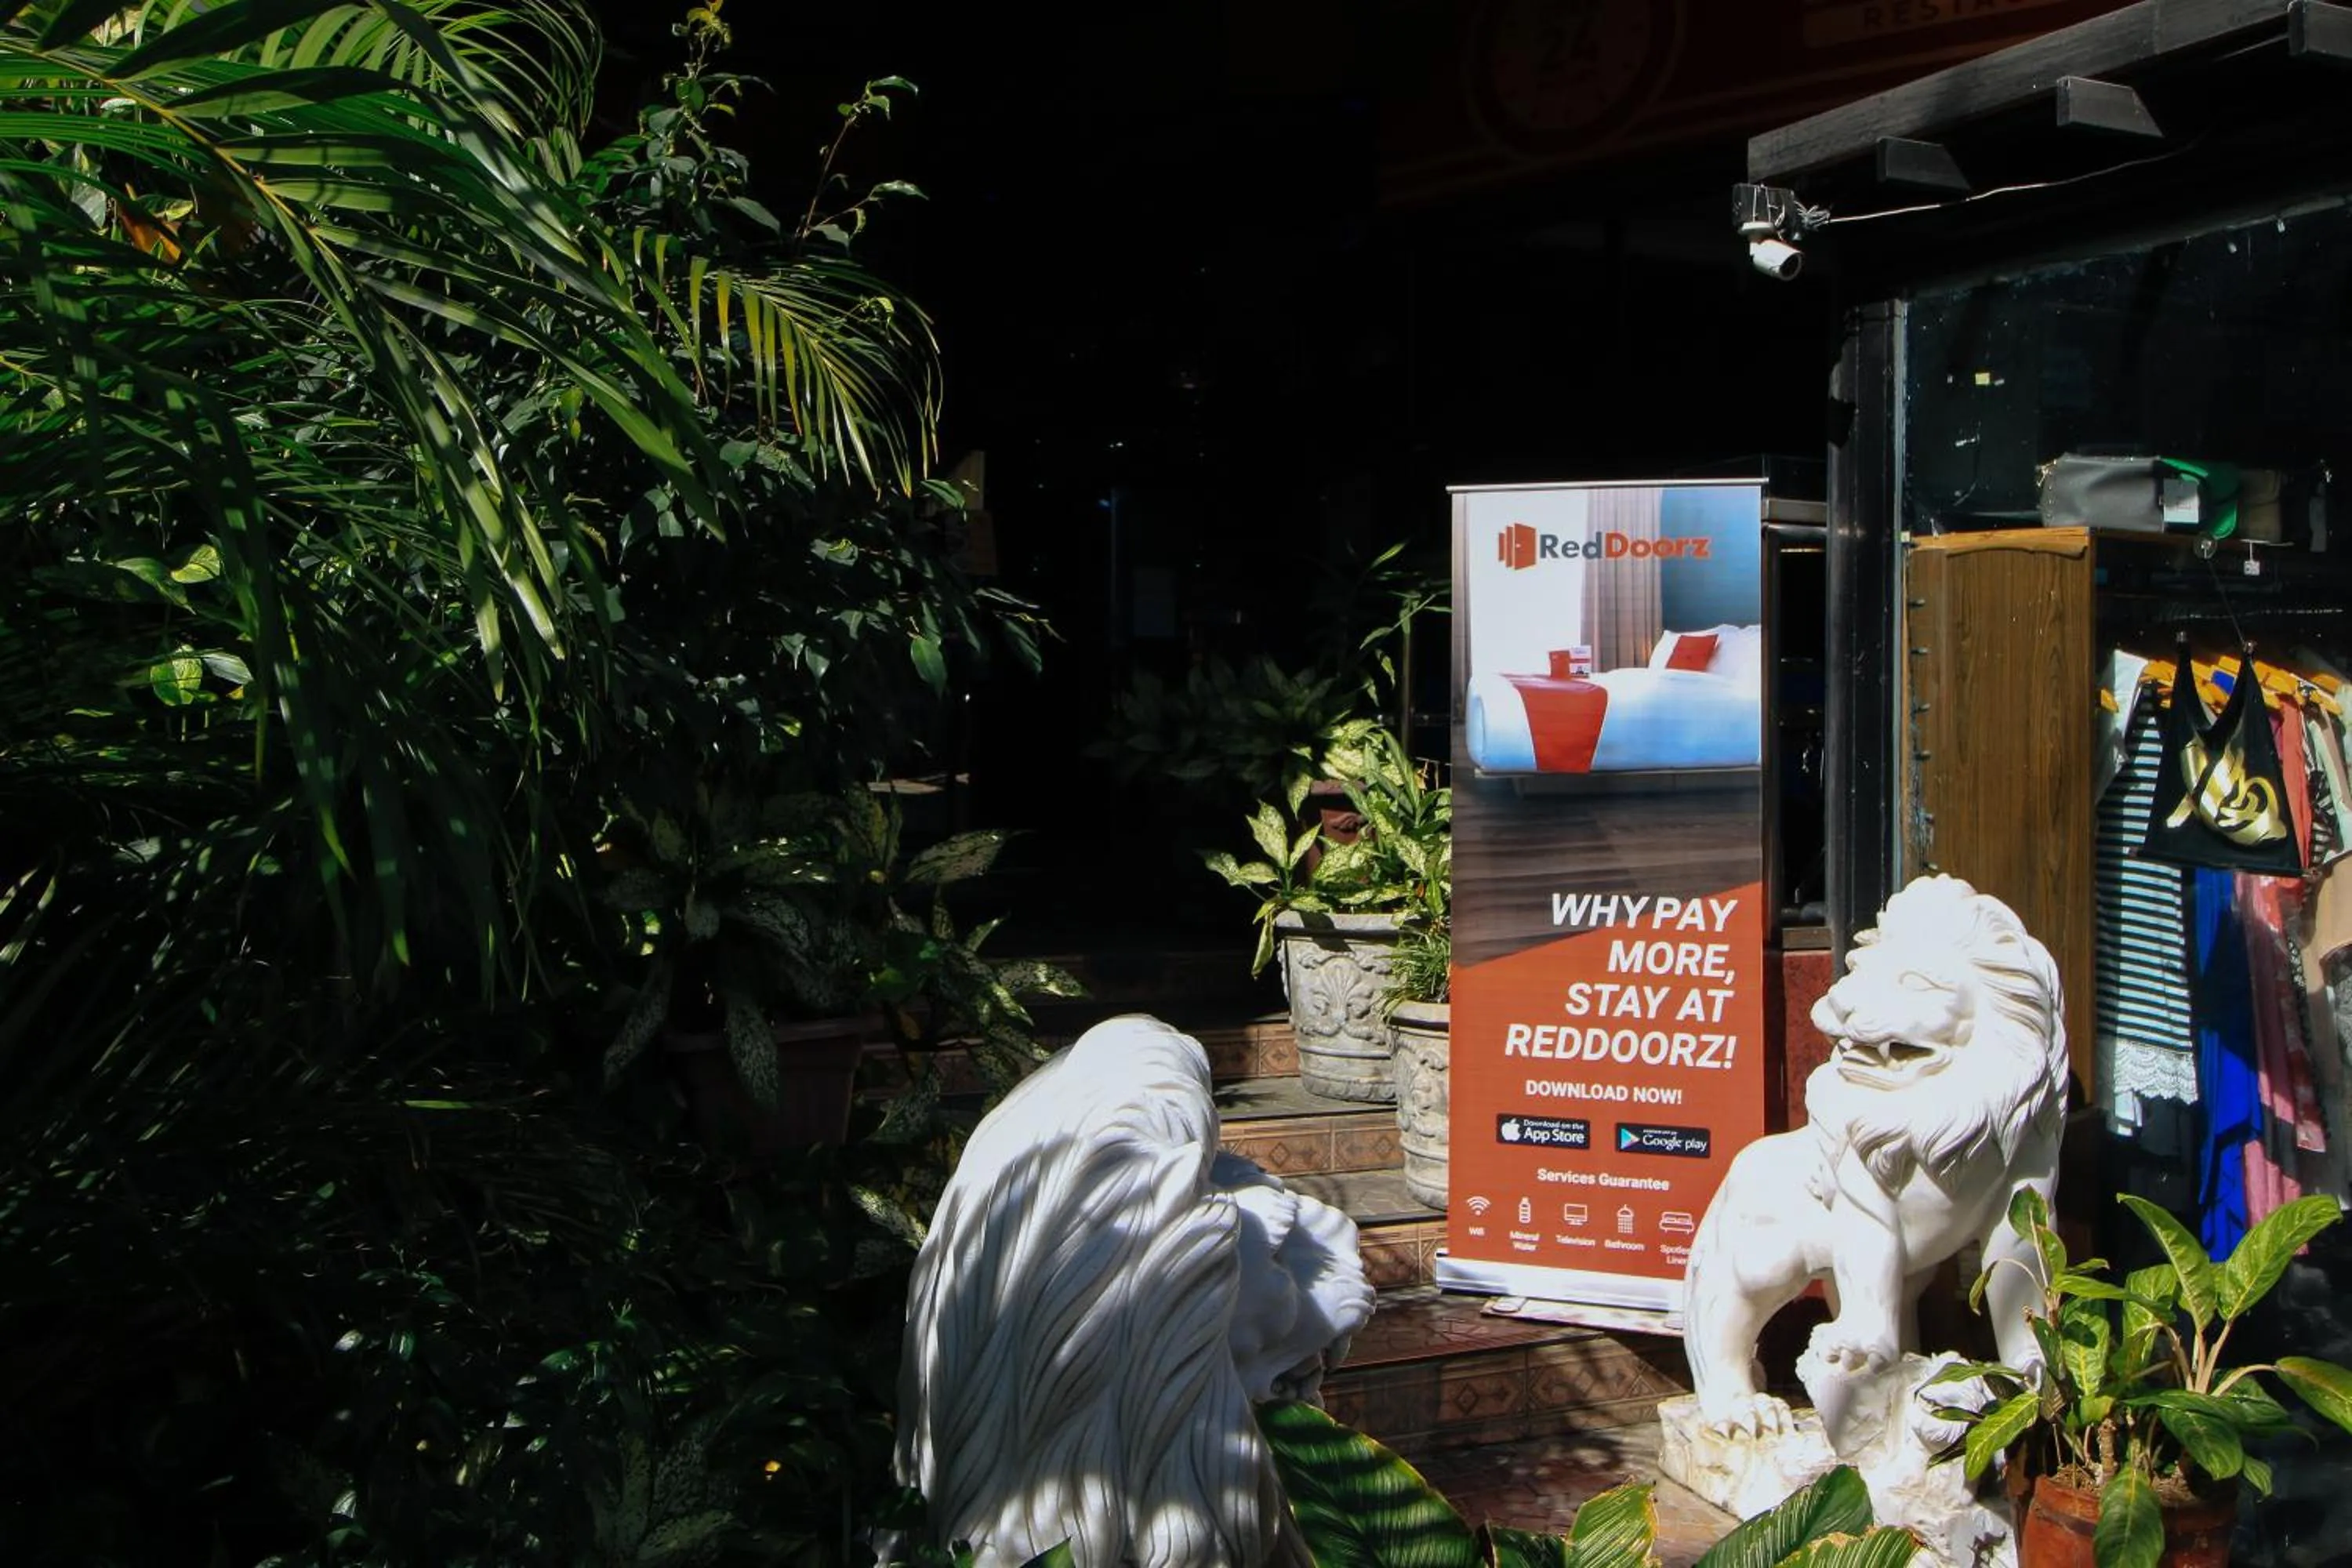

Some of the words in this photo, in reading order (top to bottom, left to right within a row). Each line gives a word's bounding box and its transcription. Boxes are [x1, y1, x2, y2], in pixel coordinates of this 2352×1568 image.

[1540, 532, 1711, 559] RedDoorz
[1552, 892, 1650, 929] WHY
[1652, 897, 1738, 932] PAY
[1607, 940, 1735, 985] MORE,
[1566, 982, 1670, 1019] STAY
[1675, 989, 1735, 1023] AT
[1504, 1023, 1737, 1069] REDDOORZ!
[1526, 1080, 1628, 1102] DOWNLOAD
[1633, 1087, 1682, 1104] NOW!
[1523, 1127, 1550, 1144] App
[1552, 1128, 1584, 1144] Store
[1642, 1134, 1682, 1151] Google
[1685, 1137, 1708, 1153] play
[1537, 1168, 1595, 1185] Services
[1599, 1174, 1670, 1191] Guarantee
